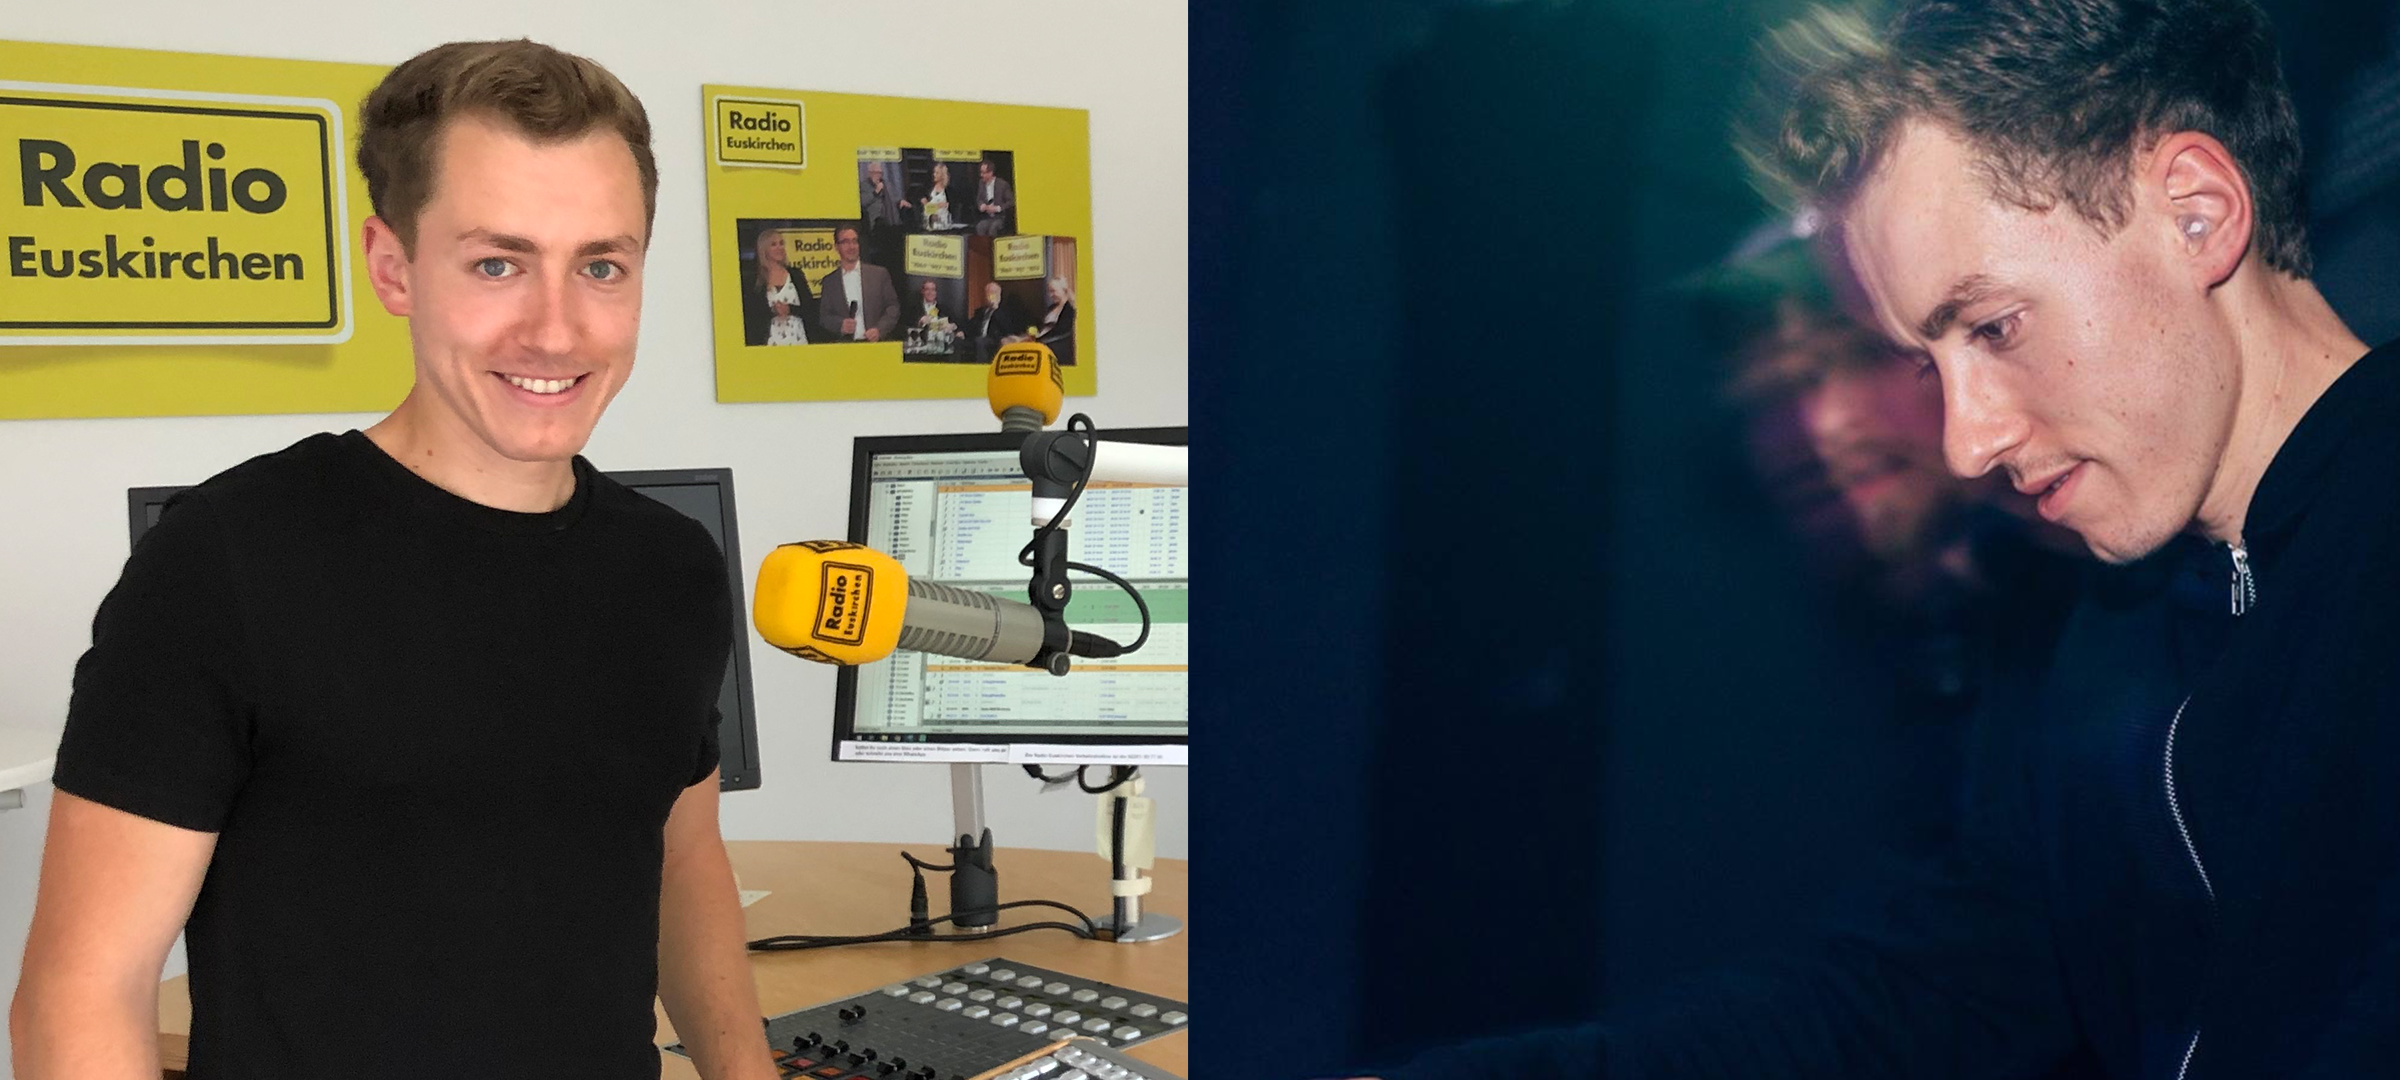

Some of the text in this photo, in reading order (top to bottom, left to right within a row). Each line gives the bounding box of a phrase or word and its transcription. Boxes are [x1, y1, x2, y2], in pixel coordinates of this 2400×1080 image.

[729, 110, 791, 132] Radio
[726, 136, 795, 151] Euskirchen
[19, 138, 287, 214] Radio
[8, 234, 304, 281] Euskirchen
[795, 238, 833, 252] Radio
[1003, 353, 1034, 362] Radio
[825, 574, 848, 630] Radio
[844, 574, 862, 635] Euskirchen
